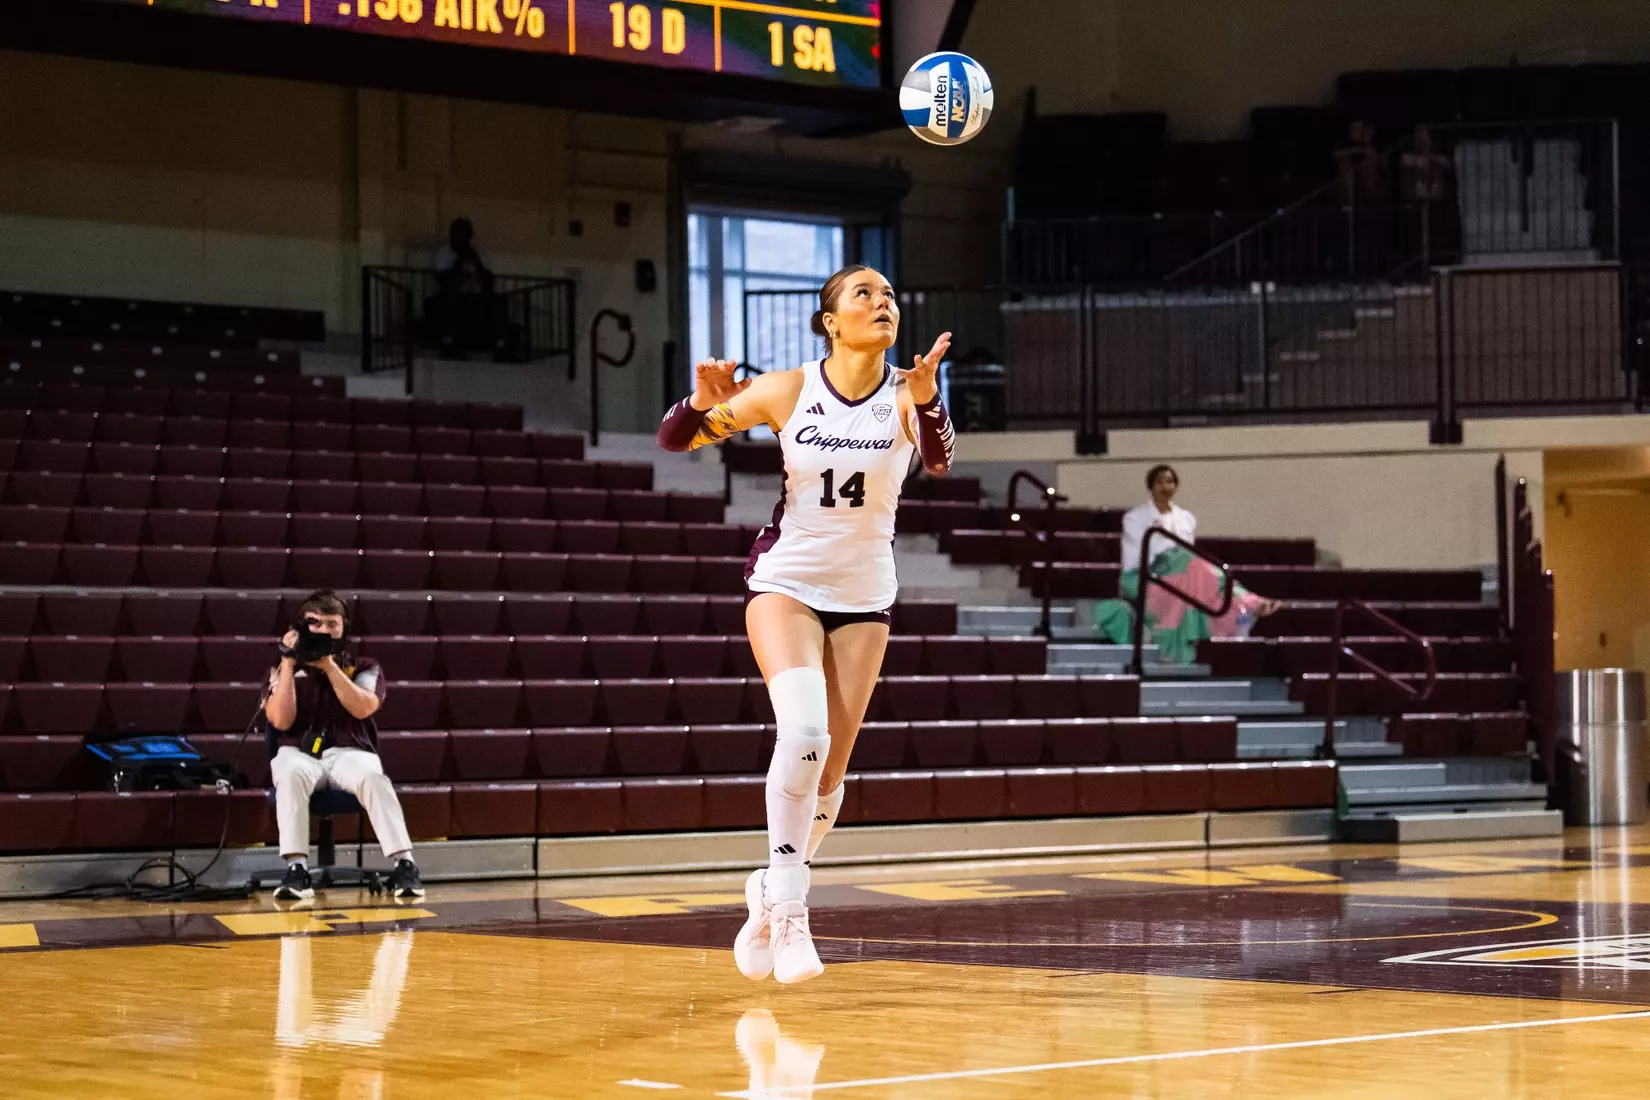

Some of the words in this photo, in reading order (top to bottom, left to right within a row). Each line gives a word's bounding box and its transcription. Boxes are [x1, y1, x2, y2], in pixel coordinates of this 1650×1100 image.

[609, 2, 651, 50] 19
[661, 7, 686, 54] D
[768, 21, 784, 66] 1
[793, 24, 836, 72] SA
[934, 75, 947, 126] molten
[951, 79, 965, 122] NCAA
[795, 425, 895, 452] Chippewas
[820, 468, 865, 507] 14
